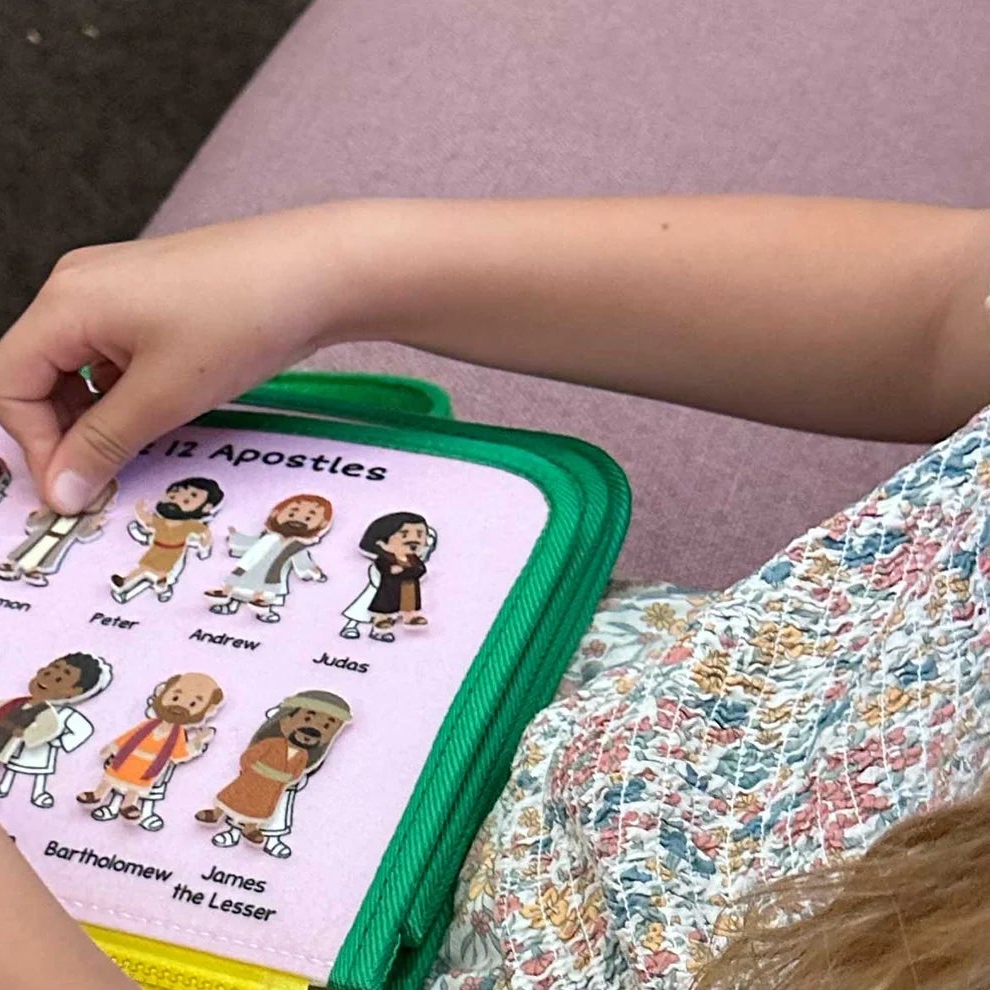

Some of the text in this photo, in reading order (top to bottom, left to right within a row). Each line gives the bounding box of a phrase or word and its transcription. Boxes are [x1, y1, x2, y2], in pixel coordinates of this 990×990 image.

[164, 440, 199, 457] 12
[208, 443, 388, 483] Apostles
[89, 612, 140, 630] Peter
[188, 628, 261, 651] Andrew
[312, 652, 370, 674] Judas
[44, 840, 173, 882] Bartholomew
[200, 866, 267, 893] James
[172, 884, 277, 922] the Lesser
